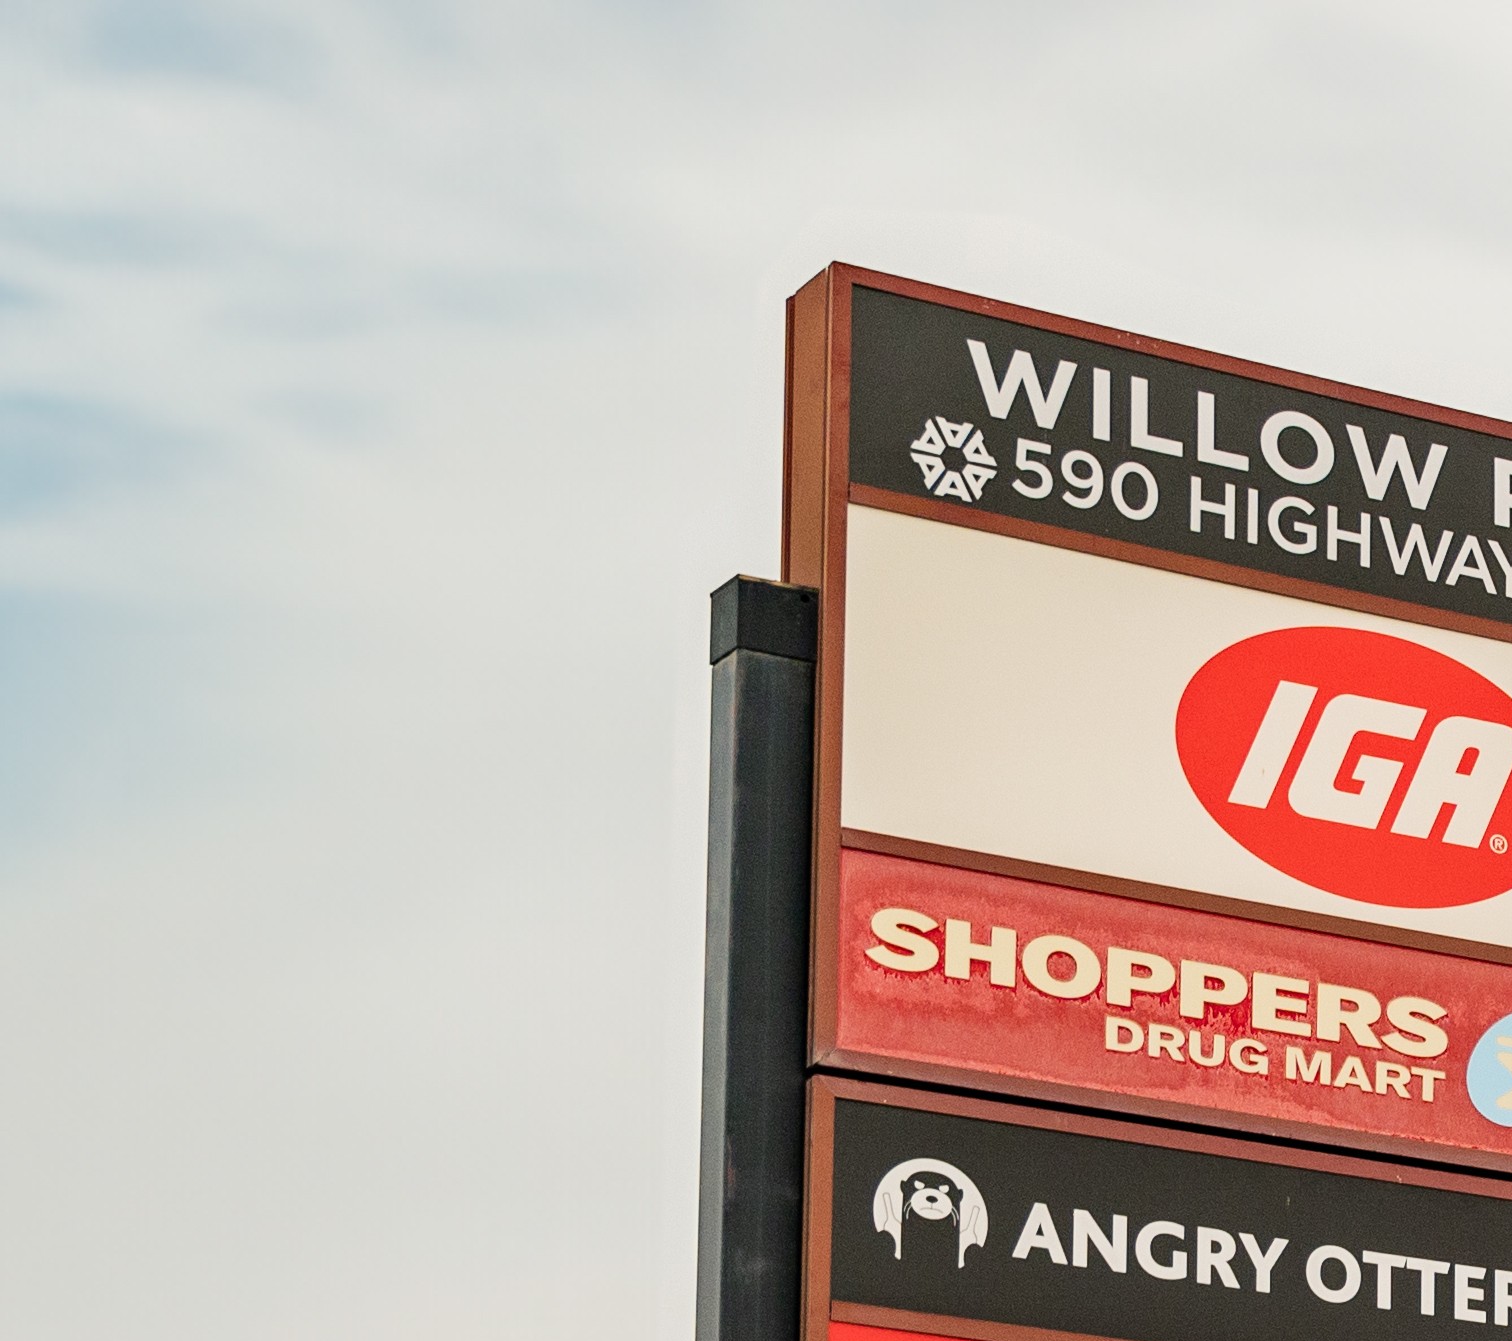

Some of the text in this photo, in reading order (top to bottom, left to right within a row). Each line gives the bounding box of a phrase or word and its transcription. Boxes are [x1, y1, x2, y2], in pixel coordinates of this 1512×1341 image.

[967, 338, 1449, 510] WILLOW
[1012, 438, 1159, 521] 590
[864, 907, 1449, 1058] SHOPPERS
[1105, 1016, 1447, 1102] DRUG MART
[1012, 1201, 1289, 1295] ANGRY
